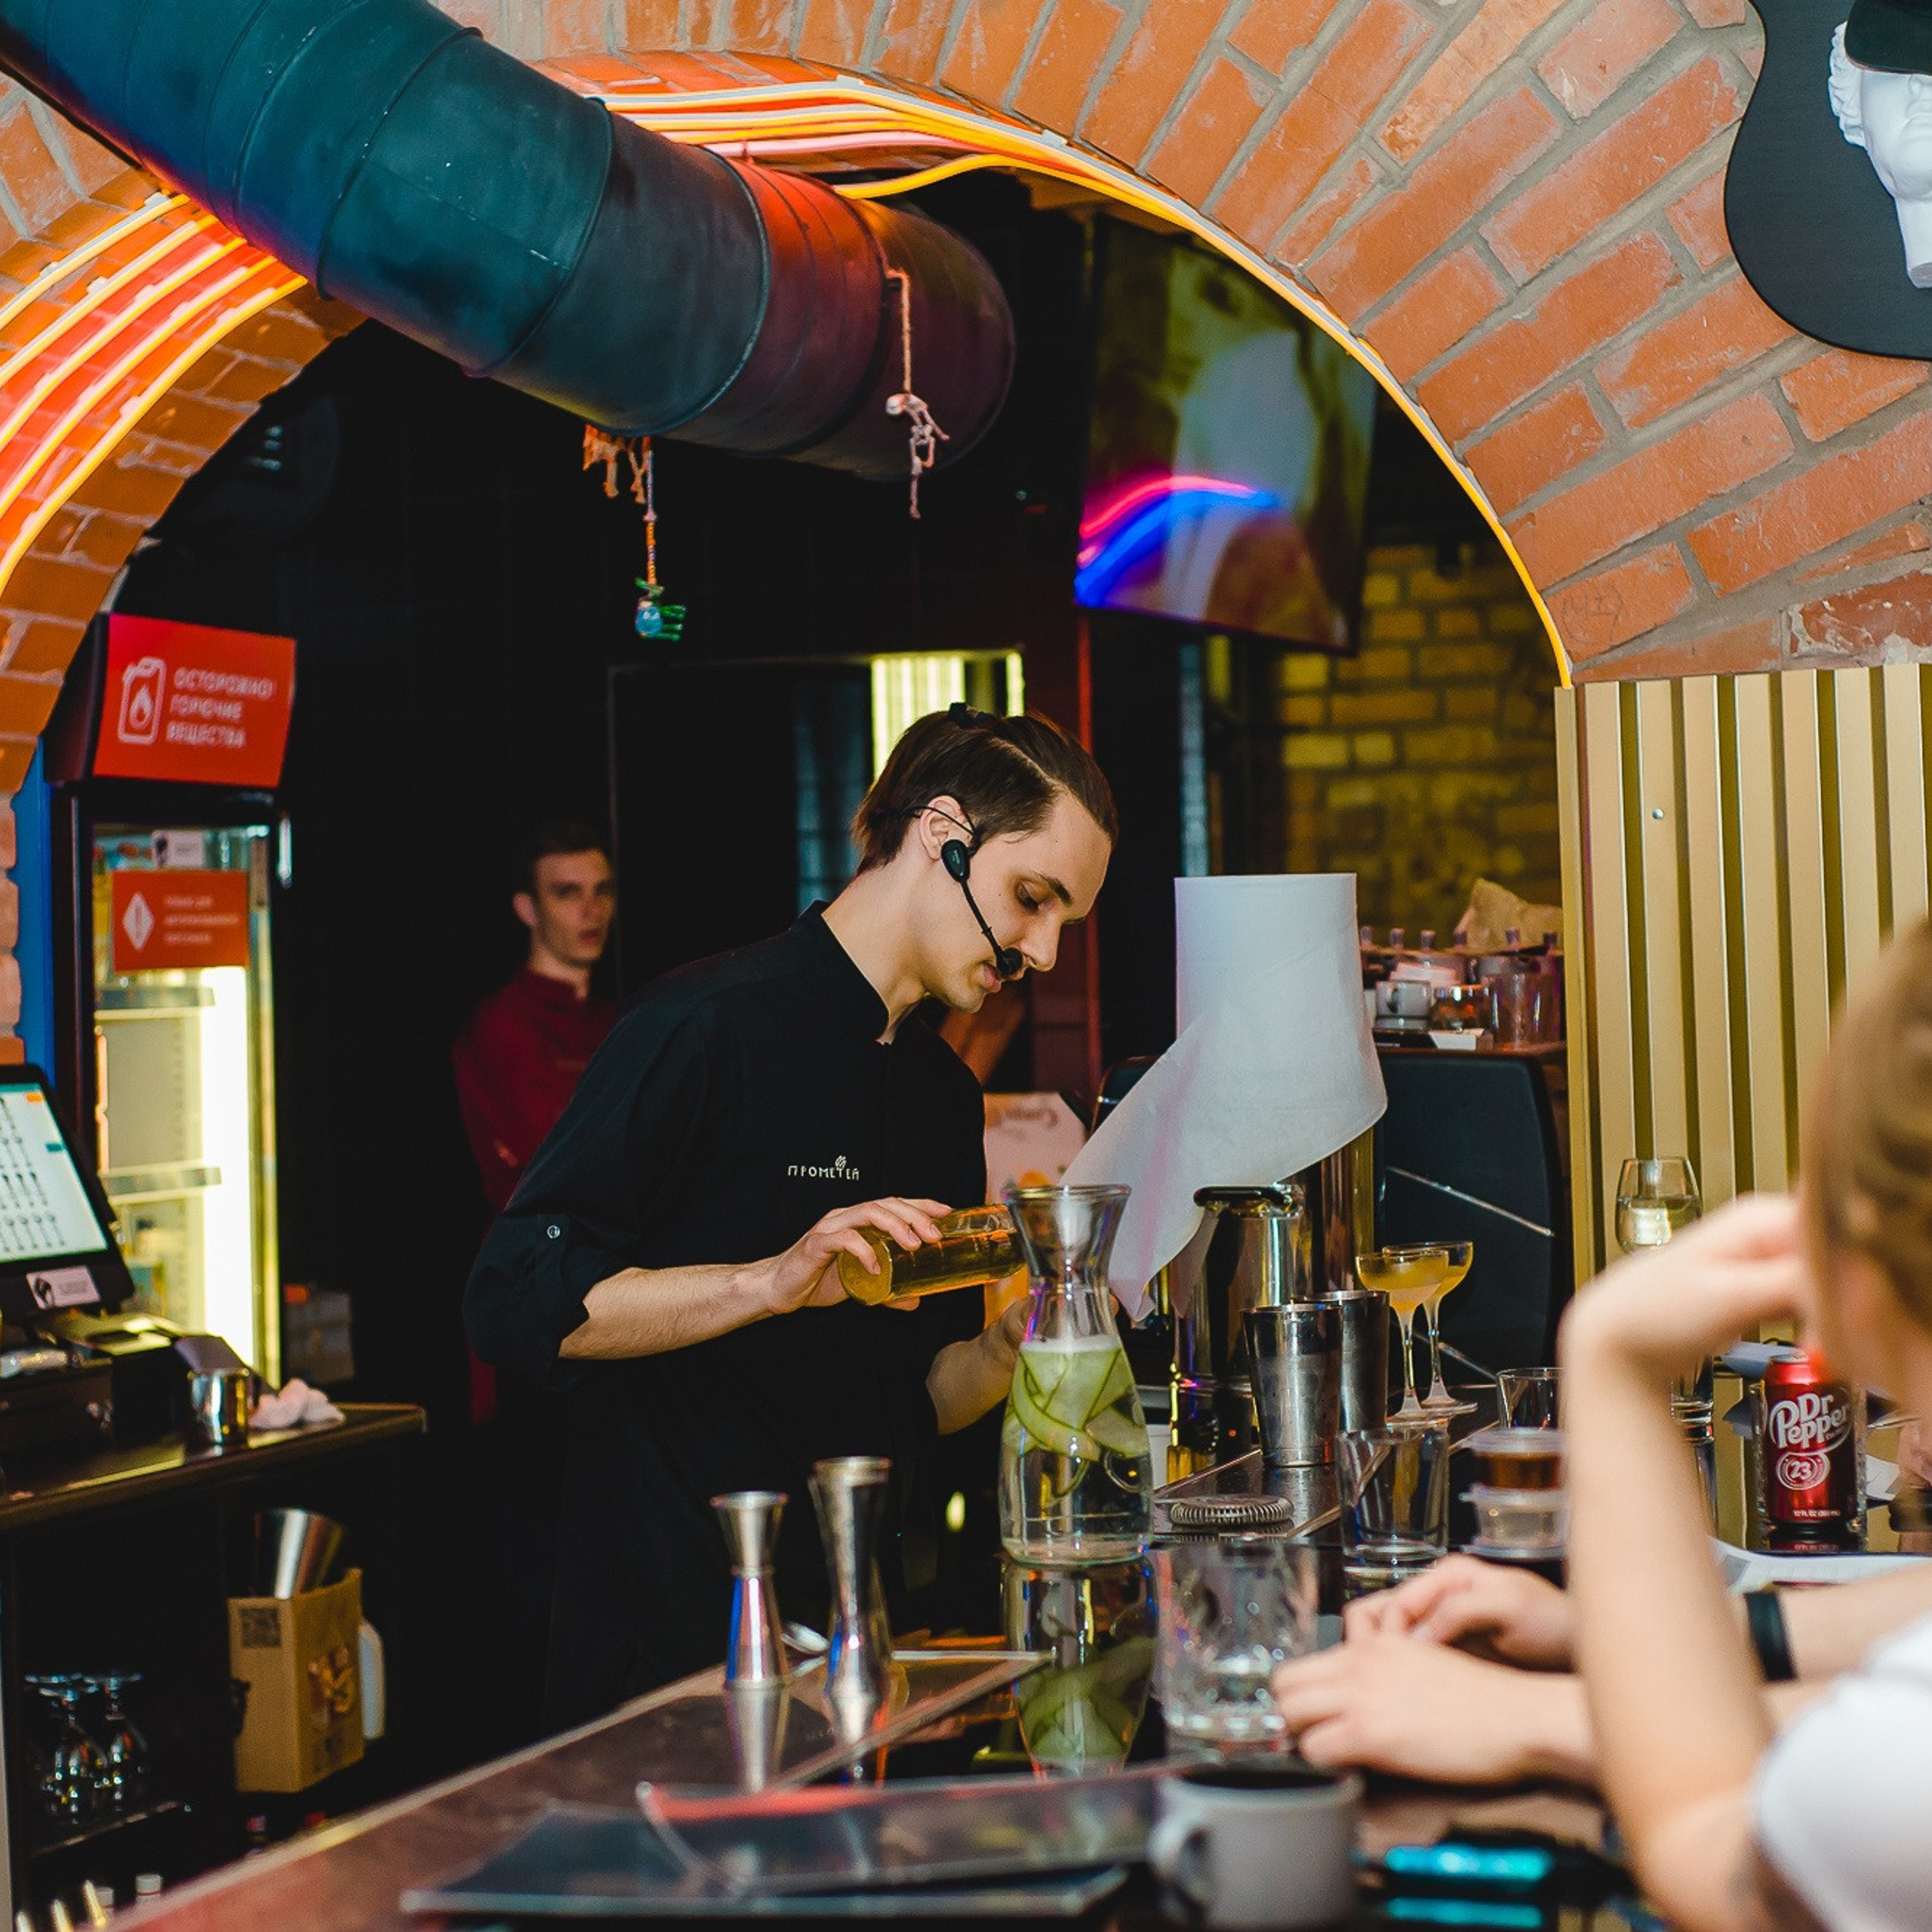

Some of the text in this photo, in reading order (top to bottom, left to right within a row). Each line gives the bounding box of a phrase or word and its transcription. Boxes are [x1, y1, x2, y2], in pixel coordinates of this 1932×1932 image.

[171, 694, 243, 722] ГОРЮЧИЕ
[166, 721, 246, 749] ВЕЩЕСТВА
[788, 1164, 860, 1180] ПРОМЕТЕЙ
[1797, 1393, 1834, 1423] Dr
[1770, 1400, 1847, 1448] Pepper
[1790, 1460, 1811, 1480] 23
